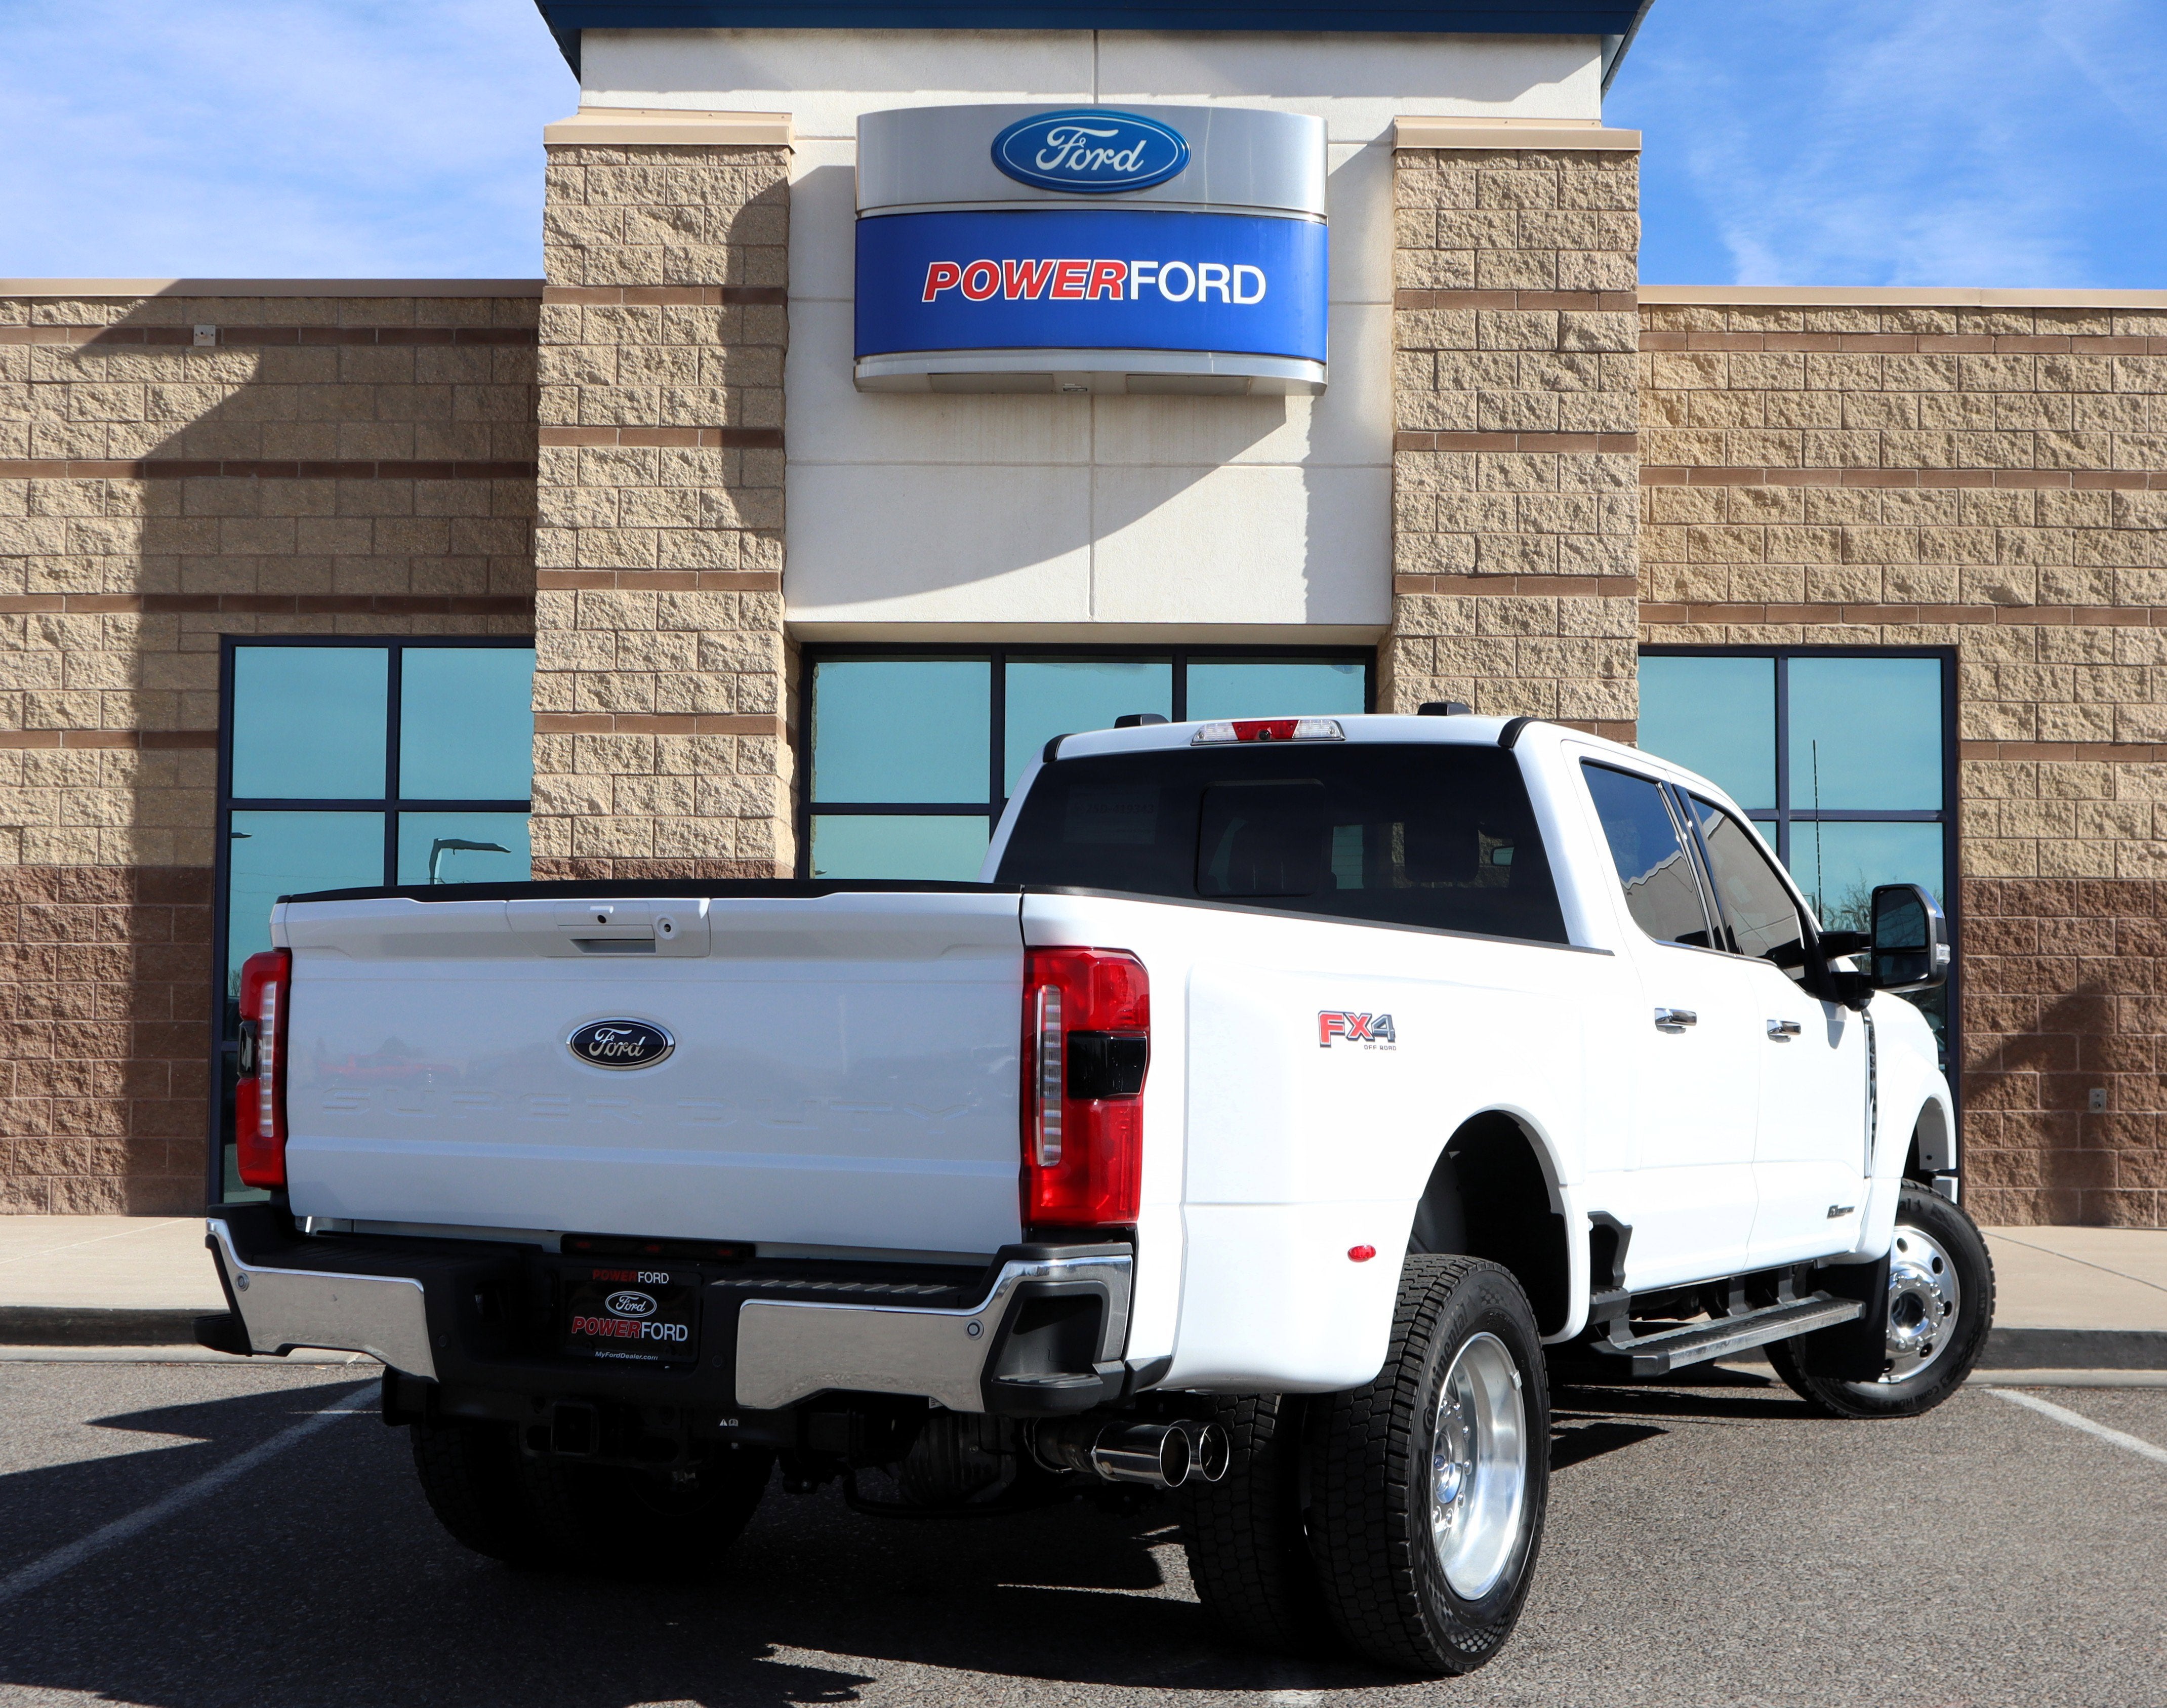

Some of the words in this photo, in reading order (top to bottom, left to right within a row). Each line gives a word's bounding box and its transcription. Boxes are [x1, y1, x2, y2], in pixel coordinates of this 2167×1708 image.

[1036, 126, 1147, 173] Ford
[589, 1028, 646, 1056] Ford
[1318, 1010, 1396, 1048] FX4
[616, 1295, 646, 1313] Ford
[595, 1351, 658, 1360] MyFordDealer.com
